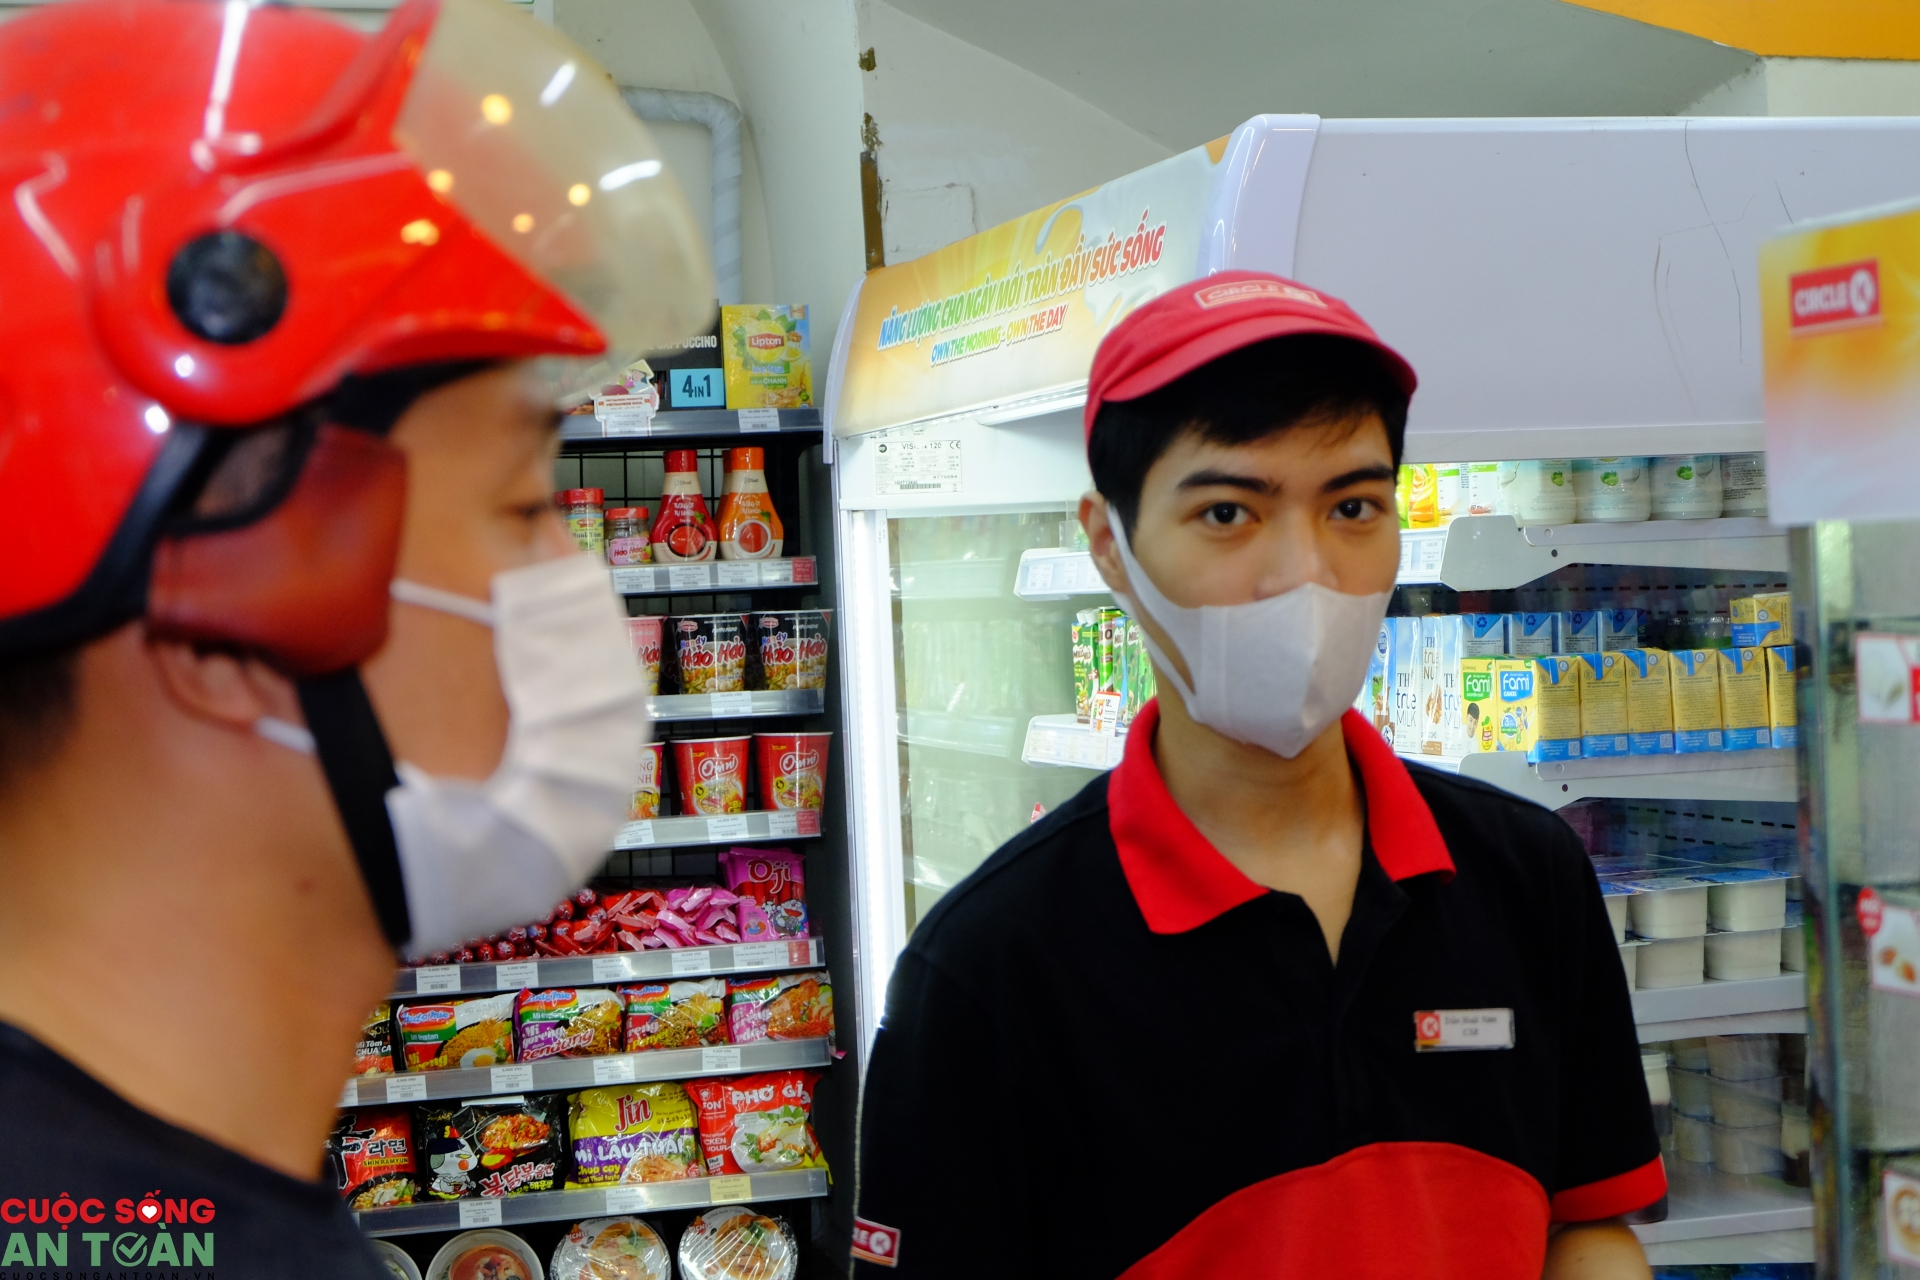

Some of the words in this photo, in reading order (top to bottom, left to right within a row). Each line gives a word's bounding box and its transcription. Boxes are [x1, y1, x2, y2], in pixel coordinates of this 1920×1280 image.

[878, 307, 907, 347] NĂNG
[905, 300, 942, 344] LƯỢNG
[941, 294, 965, 329] CHO
[963, 275, 998, 321] NGÀY
[995, 262, 1024, 312] MỚI
[1024, 254, 1060, 303] TRÀN
[1060, 232, 1092, 291] ĐẦY
[1089, 231, 1122, 282] SỨC
[1120, 209, 1166, 272] SỐNG
[1794, 281, 1849, 316] CIRCLE
[751, 337, 782, 346] Lipton
[931, 341, 951, 362] OWN
[949, 336, 966, 358] THE
[965, 325, 1002, 352] MORNING
[1006, 318, 1029, 341] OWN
[1028, 311, 1047, 333] THE
[1045, 305, 1068, 329] DAY
[763, 377, 788, 385] CHANH
[681, 634, 707, 649] Handy
[762, 641, 795, 665] Hảo
[799, 633, 827, 660] Hảo
[681, 645, 714, 668] Hảo
[717, 636, 746, 663] Hảo
[1397, 673, 1410, 688] TH
[1466, 675, 1491, 692] Fami
[1503, 673, 1530, 691] Fami
[1396, 689, 1417, 710] true
[701, 756, 735, 777] Omni
[782, 752, 817, 772] Omni
[747, 860, 790, 894] Oji
[626, 1021, 659, 1037] reng
[522, 1030, 595, 1062] Rendang
[615, 1094, 653, 1132] Jin
[367, 1138, 407, 1157] 라면
[703, 1137, 727, 1145] CKEN
[380, 1157, 409, 1165] RAMYUN
[602, 1164, 620, 1174] cay
[479, 1162, 555, 1197] 불닭볶음면
